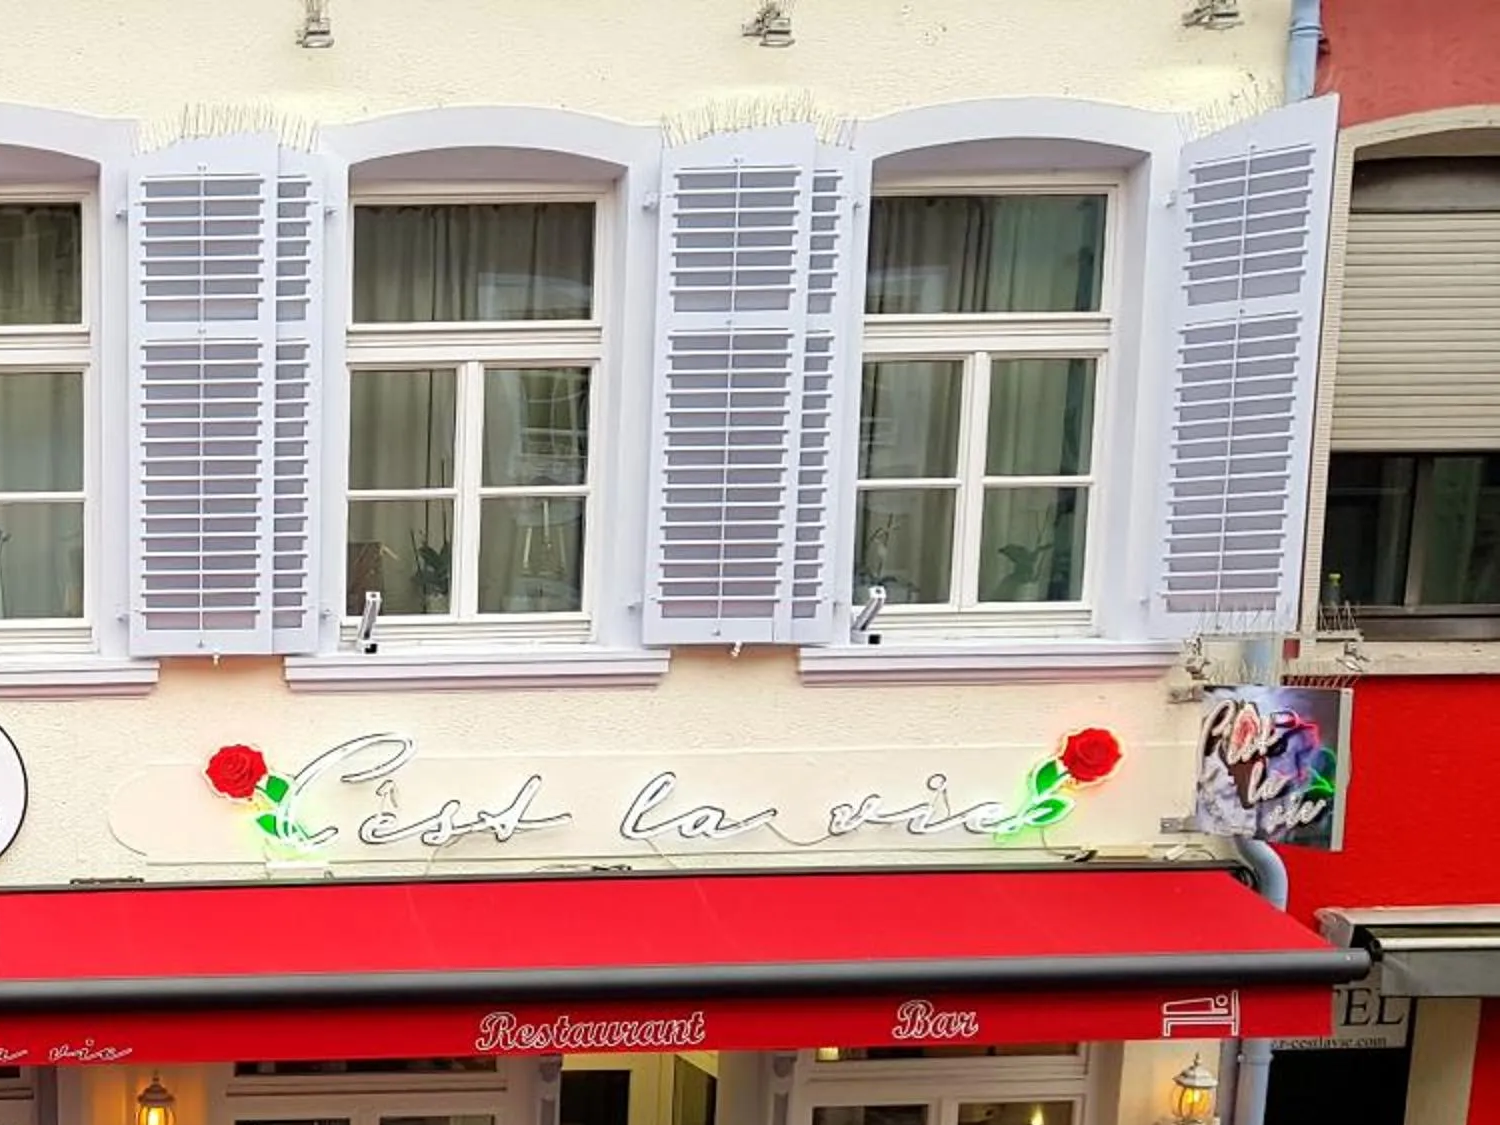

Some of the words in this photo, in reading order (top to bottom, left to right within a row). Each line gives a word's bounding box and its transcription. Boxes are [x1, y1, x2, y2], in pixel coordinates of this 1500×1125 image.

[276, 731, 574, 850] C'est
[620, 771, 778, 841] la
[828, 773, 1030, 838] vie
[474, 1010, 706, 1051] Restaurant
[891, 1000, 980, 1039] Bar
[49, 1039, 133, 1061] vie
